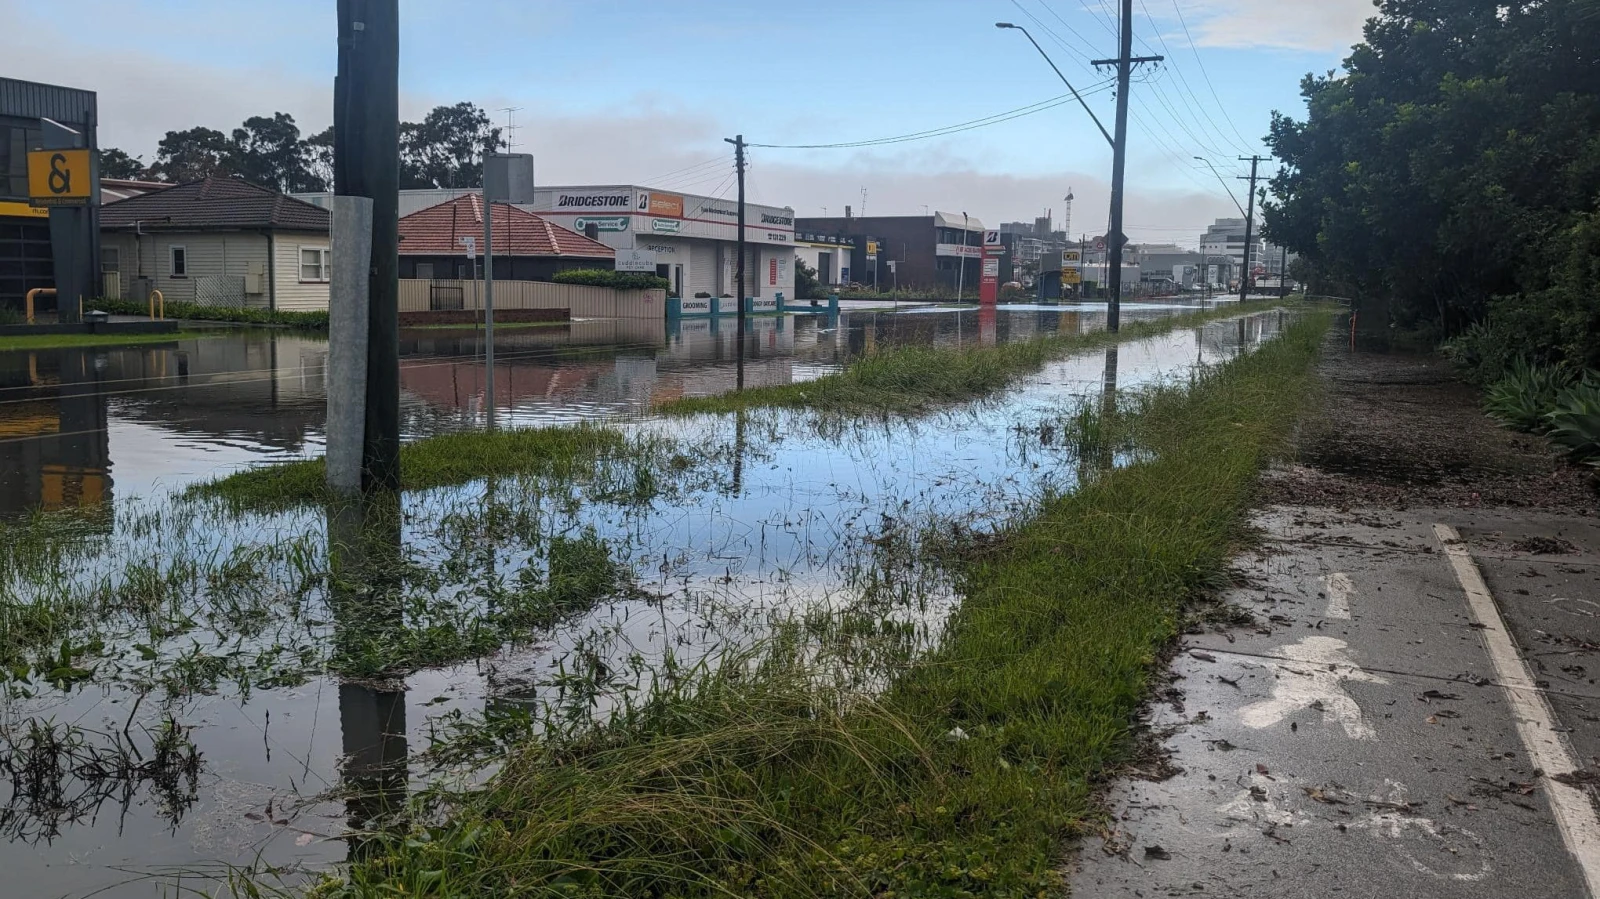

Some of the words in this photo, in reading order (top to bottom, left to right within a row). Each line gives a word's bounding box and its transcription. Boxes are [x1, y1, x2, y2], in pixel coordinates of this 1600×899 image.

[48, 153, 71, 194] &
[558, 195, 630, 206] BRIDGESTONE
[651, 200, 680, 210] select
[761, 213, 793, 226] BRIDGESTONE
[648, 245, 676, 253] RECEPTION
